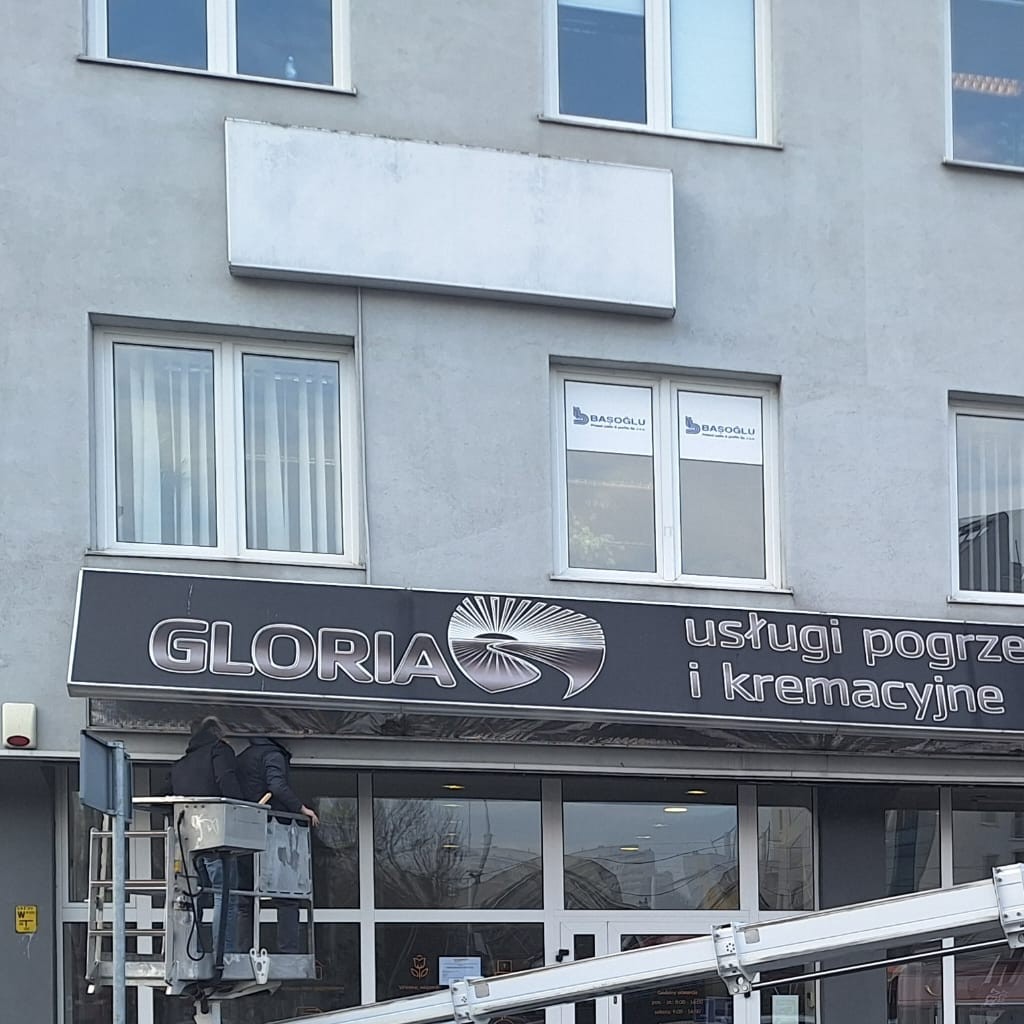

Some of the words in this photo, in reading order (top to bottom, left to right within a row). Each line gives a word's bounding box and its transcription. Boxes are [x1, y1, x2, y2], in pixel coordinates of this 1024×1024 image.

[148, 616, 457, 688] GLORIA
[684, 612, 842, 663] usługi
[687, 662, 702, 699] i
[722, 663, 1006, 722] kremacyjne
